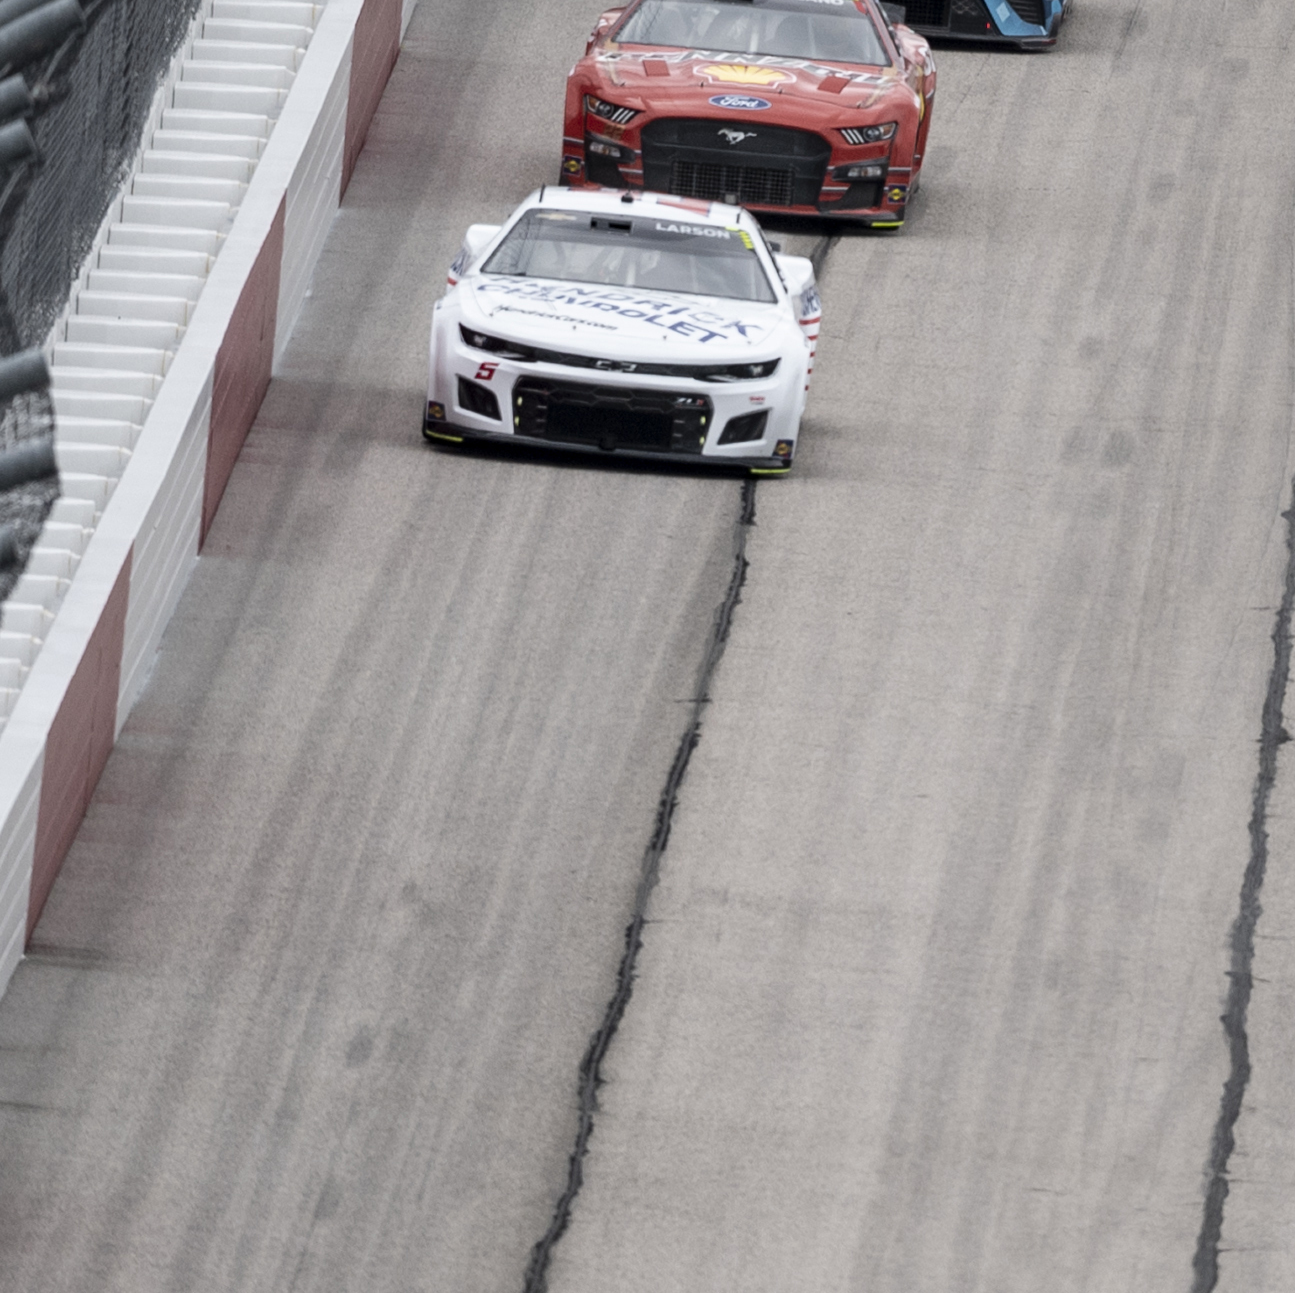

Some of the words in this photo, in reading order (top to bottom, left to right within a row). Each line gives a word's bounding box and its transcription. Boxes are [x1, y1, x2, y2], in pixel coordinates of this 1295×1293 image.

[719, 95, 760, 109] Ford
[655, 222, 731, 239] LARSON
[487, 274, 764, 338] HENDRICK
[474, 361, 501, 381] 5
